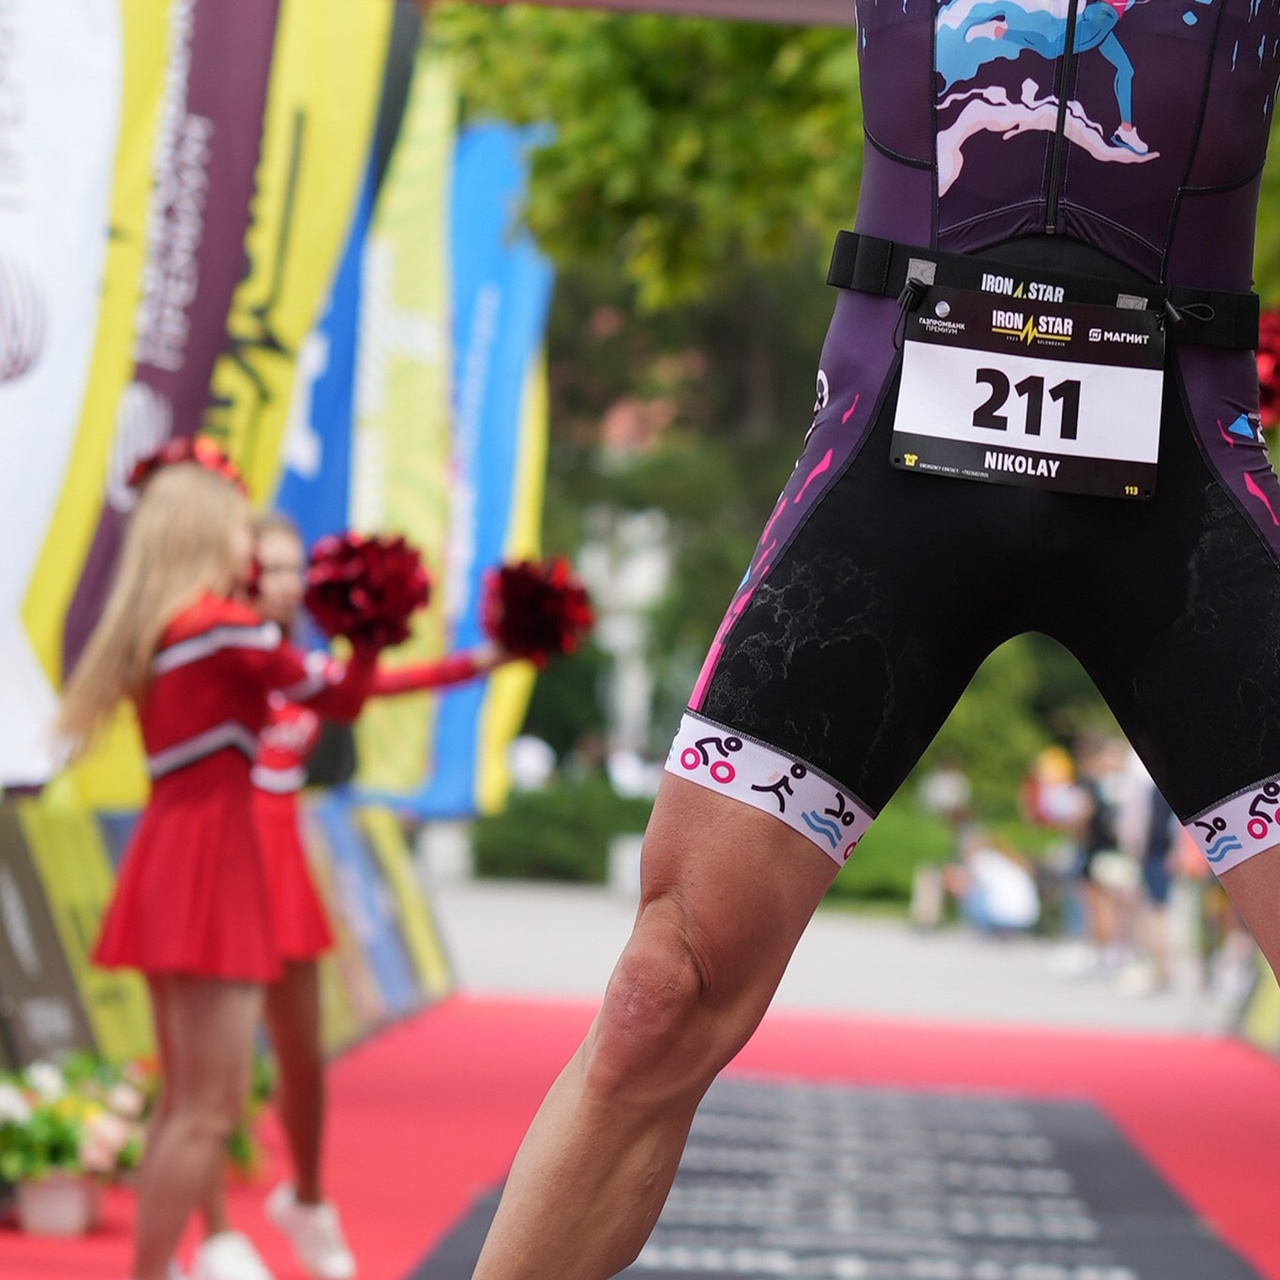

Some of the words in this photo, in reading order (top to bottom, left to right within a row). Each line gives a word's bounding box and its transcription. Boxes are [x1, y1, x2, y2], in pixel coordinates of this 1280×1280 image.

[981, 273, 1013, 295] IRON
[1028, 281, 1064, 303] STAR
[992, 310, 1024, 329] IRON
[1038, 315, 1073, 335] STAR
[1104, 331, 1149, 345] МАГНИТ
[972, 368, 1081, 440] 211
[984, 451, 1060, 478] NIKOLAY
[1124, 486, 1139, 496] 113
